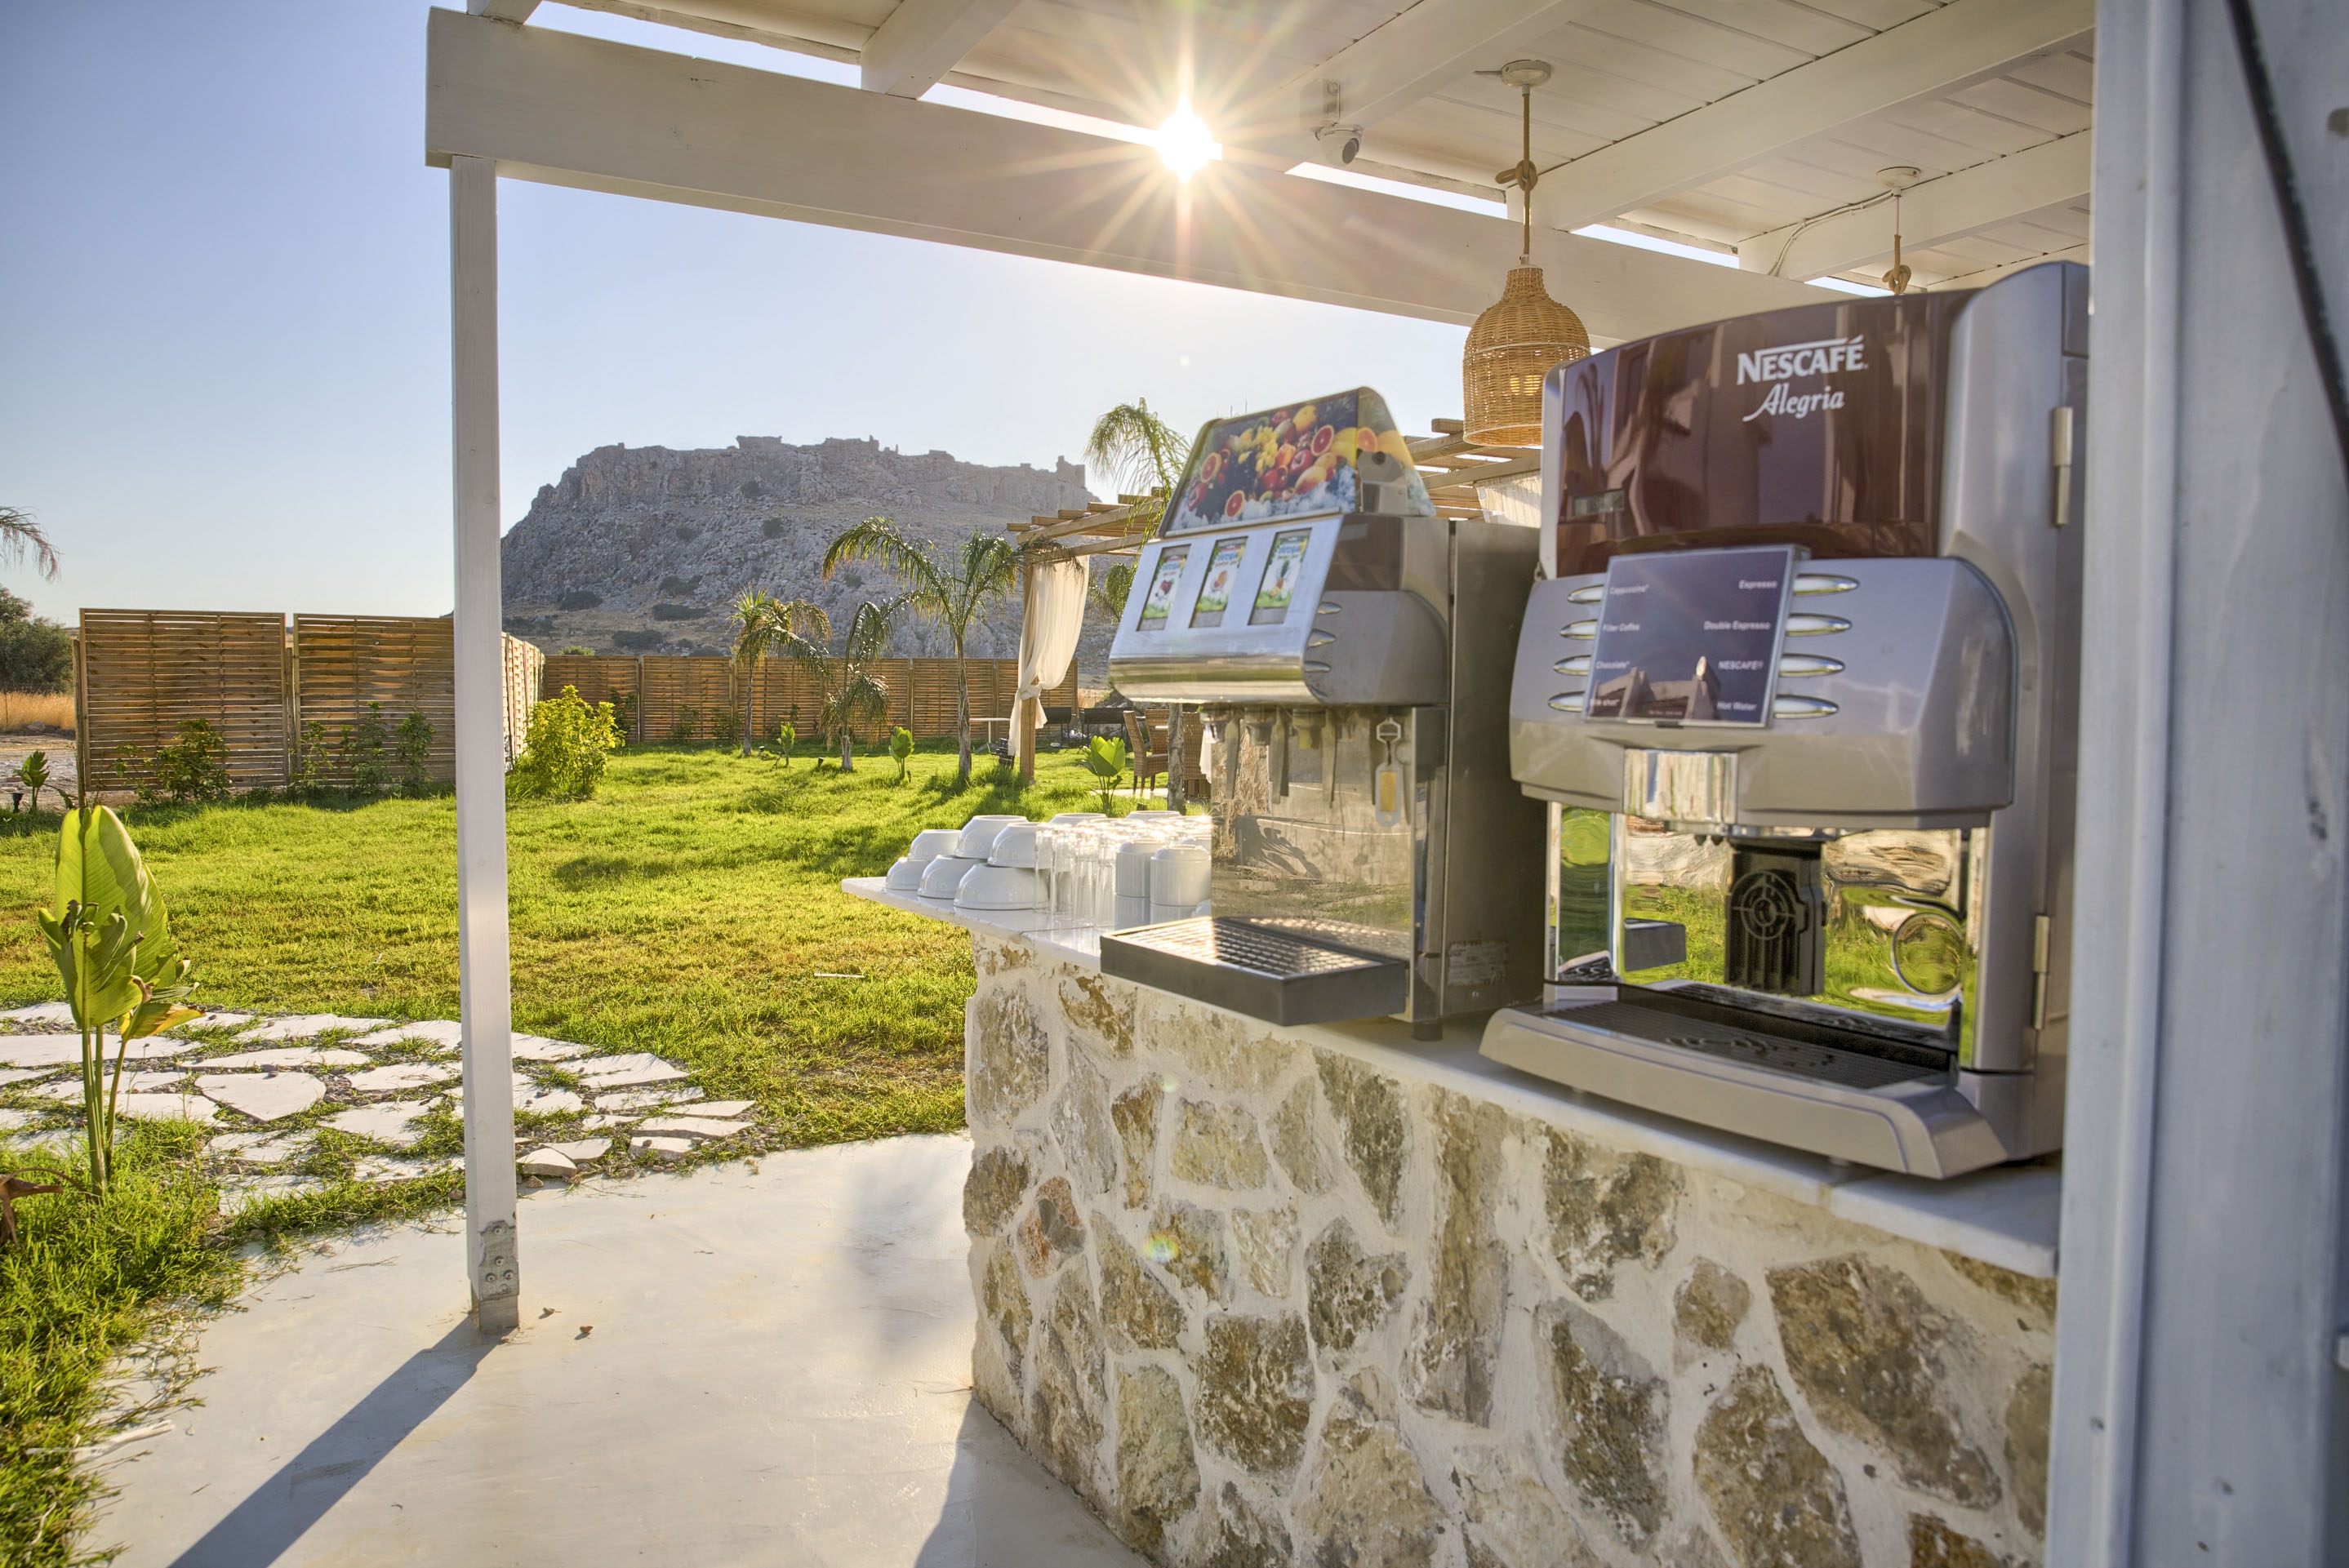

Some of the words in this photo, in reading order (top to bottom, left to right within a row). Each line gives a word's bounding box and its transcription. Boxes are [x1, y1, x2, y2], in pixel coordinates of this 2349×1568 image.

[1737, 335, 1866, 385] NESCAFÉ
[1742, 382, 1845, 422] Alegria
[1738, 580, 1777, 589] Espresso
[1619, 623, 1640, 632] Coffee
[1704, 620, 1731, 630] Double
[1733, 620, 1771, 631] Espresso
[1717, 701, 1731, 710] Hot
[1733, 702, 1757, 711] Water
